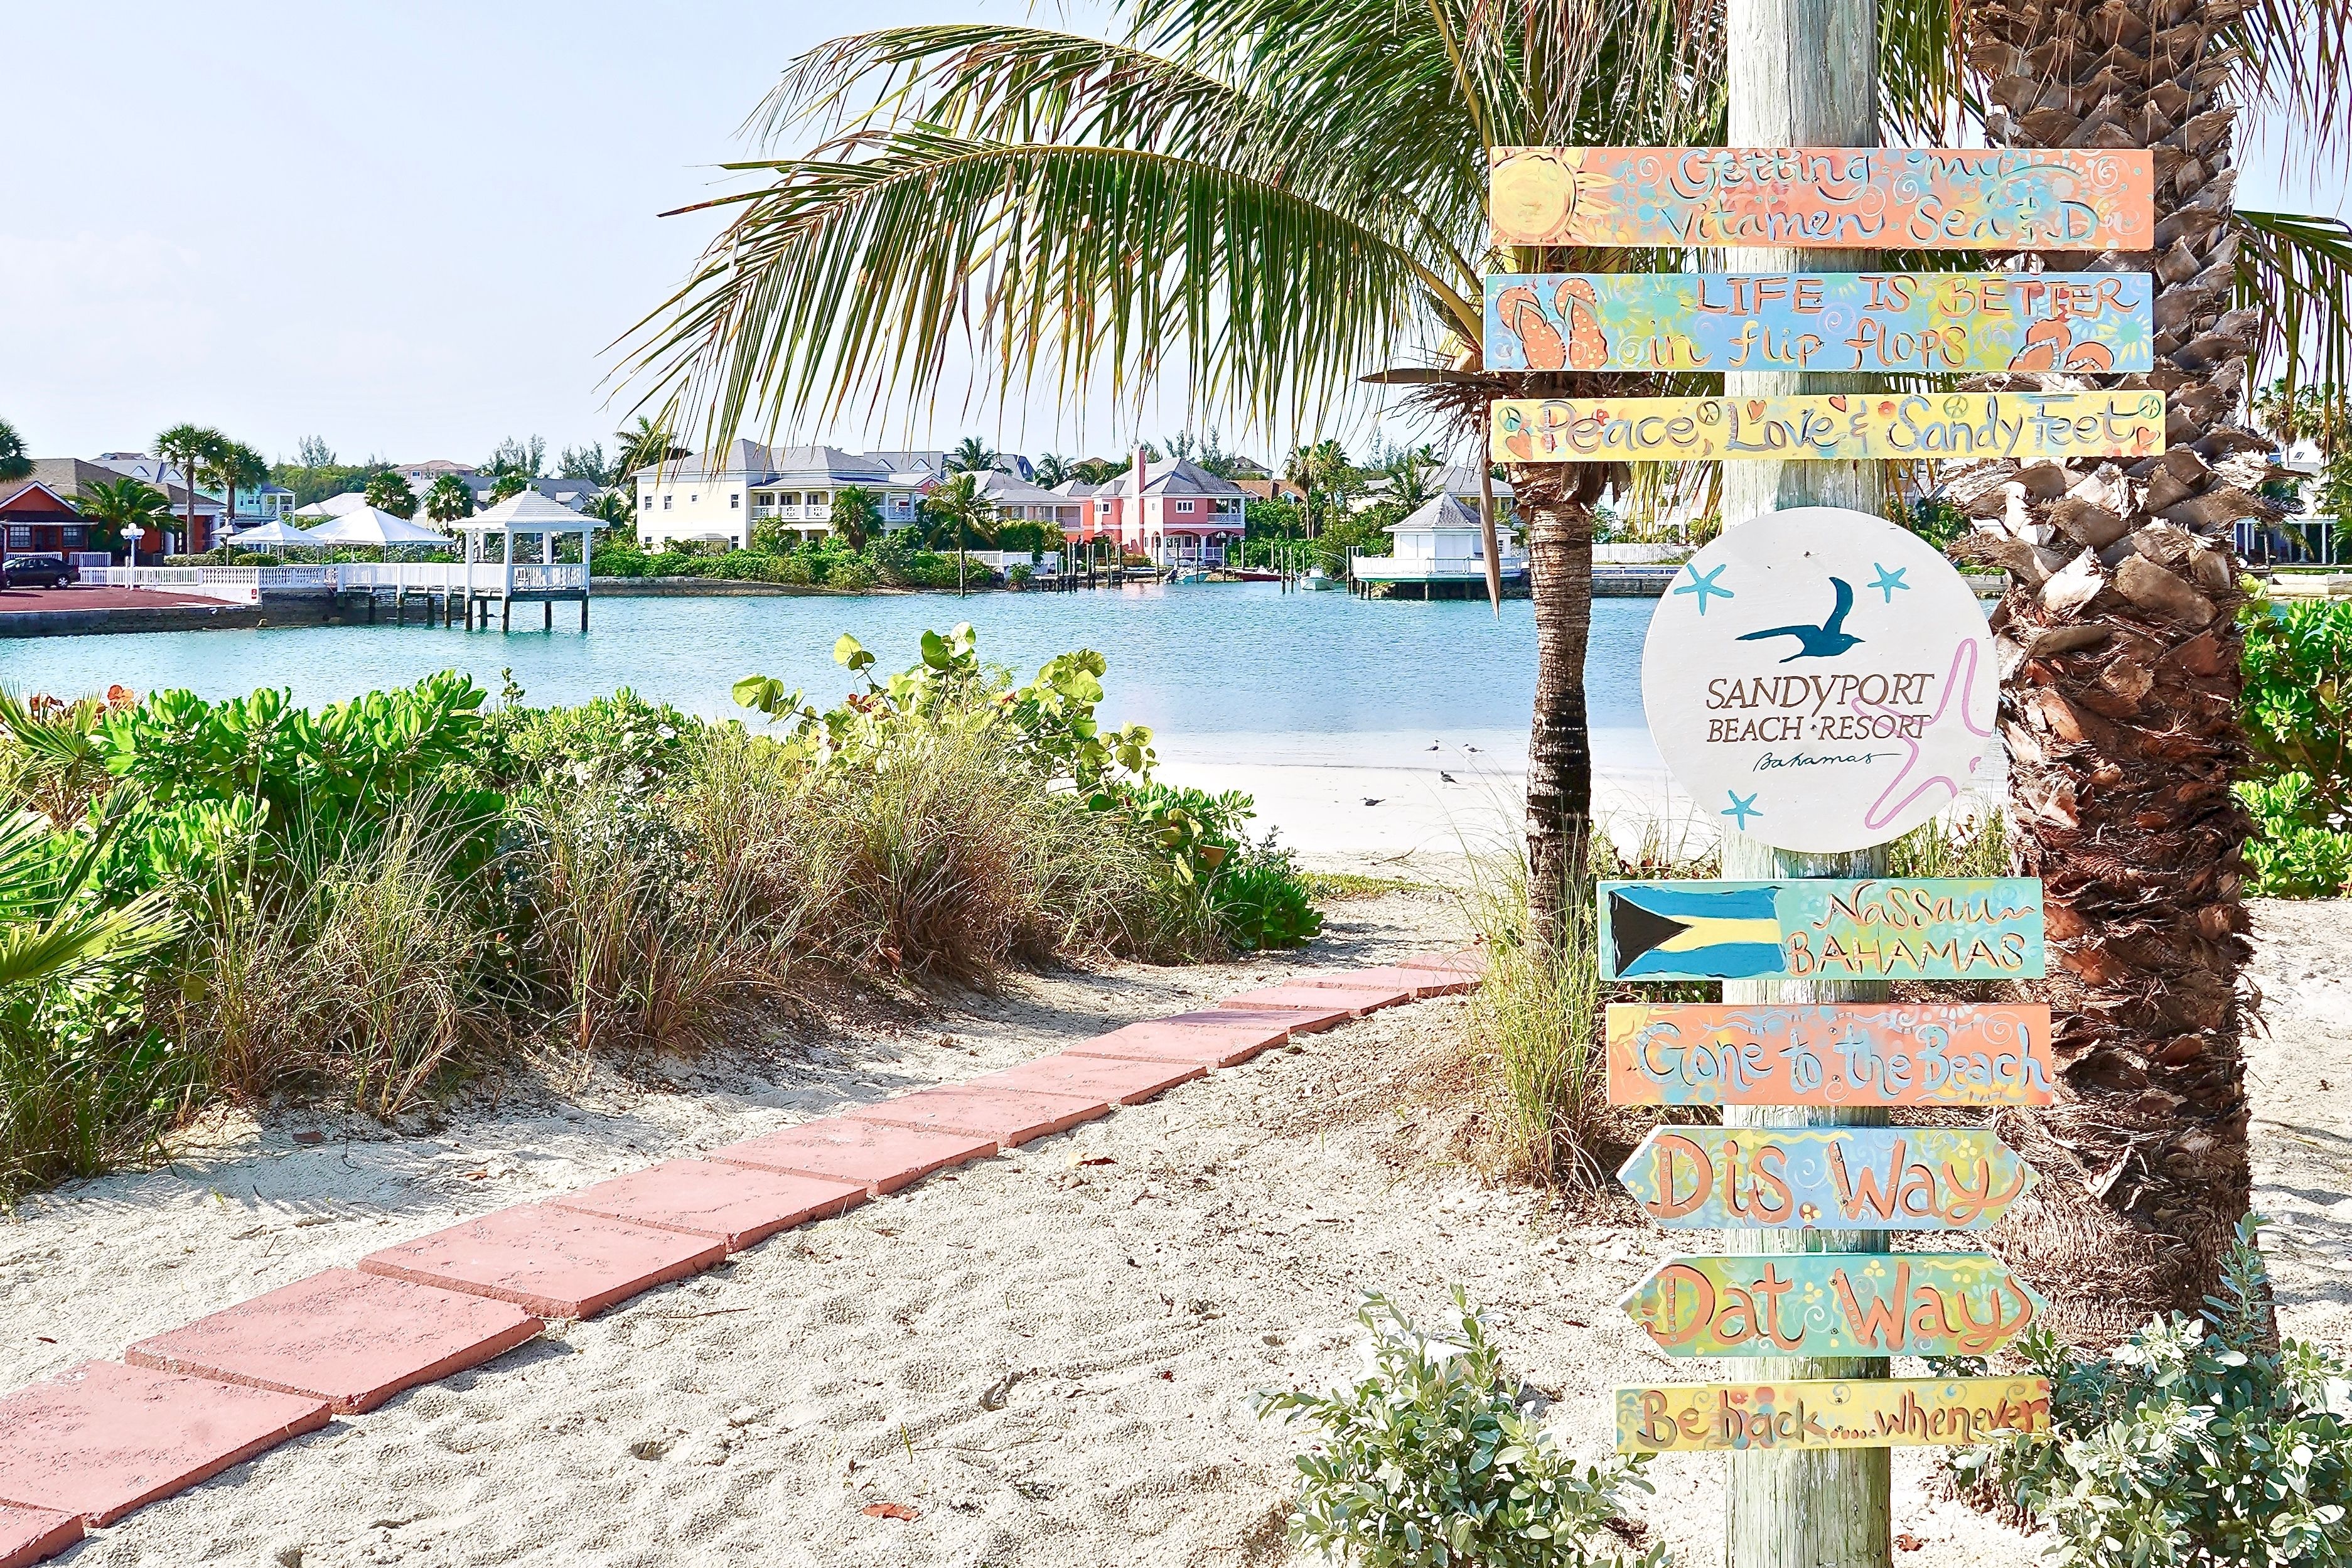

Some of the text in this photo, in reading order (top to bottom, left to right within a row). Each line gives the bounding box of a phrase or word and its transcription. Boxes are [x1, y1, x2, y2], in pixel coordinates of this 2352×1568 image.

[1665, 150, 2084, 209] Getting my
[1906, 194, 2012, 244] Sea
[2046, 200, 2100, 244] D
[1695, 275, 2140, 319] LIFE IS BETTER
[1650, 320, 1714, 369] in
[1728, 320, 1825, 369] flip
[1535, 394, 2144, 456] Peace, Love & Sandy Feet
[1705, 673, 1935, 717] SANDYPORT
[1706, 714, 1934, 743] BEACH RESORT
[1752, 752, 1903, 773] Bahamas
[1810, 879, 2037, 931] Nassau
[1785, 931, 2026, 977] BAHAMAS
[1635, 1021, 2051, 1100] Gone to the Beach
[1645, 1134, 2026, 1226] Dis Way
[1641, 1261, 2034, 1355] Dat Way
[1636, 1389, 1711, 1447] Be
